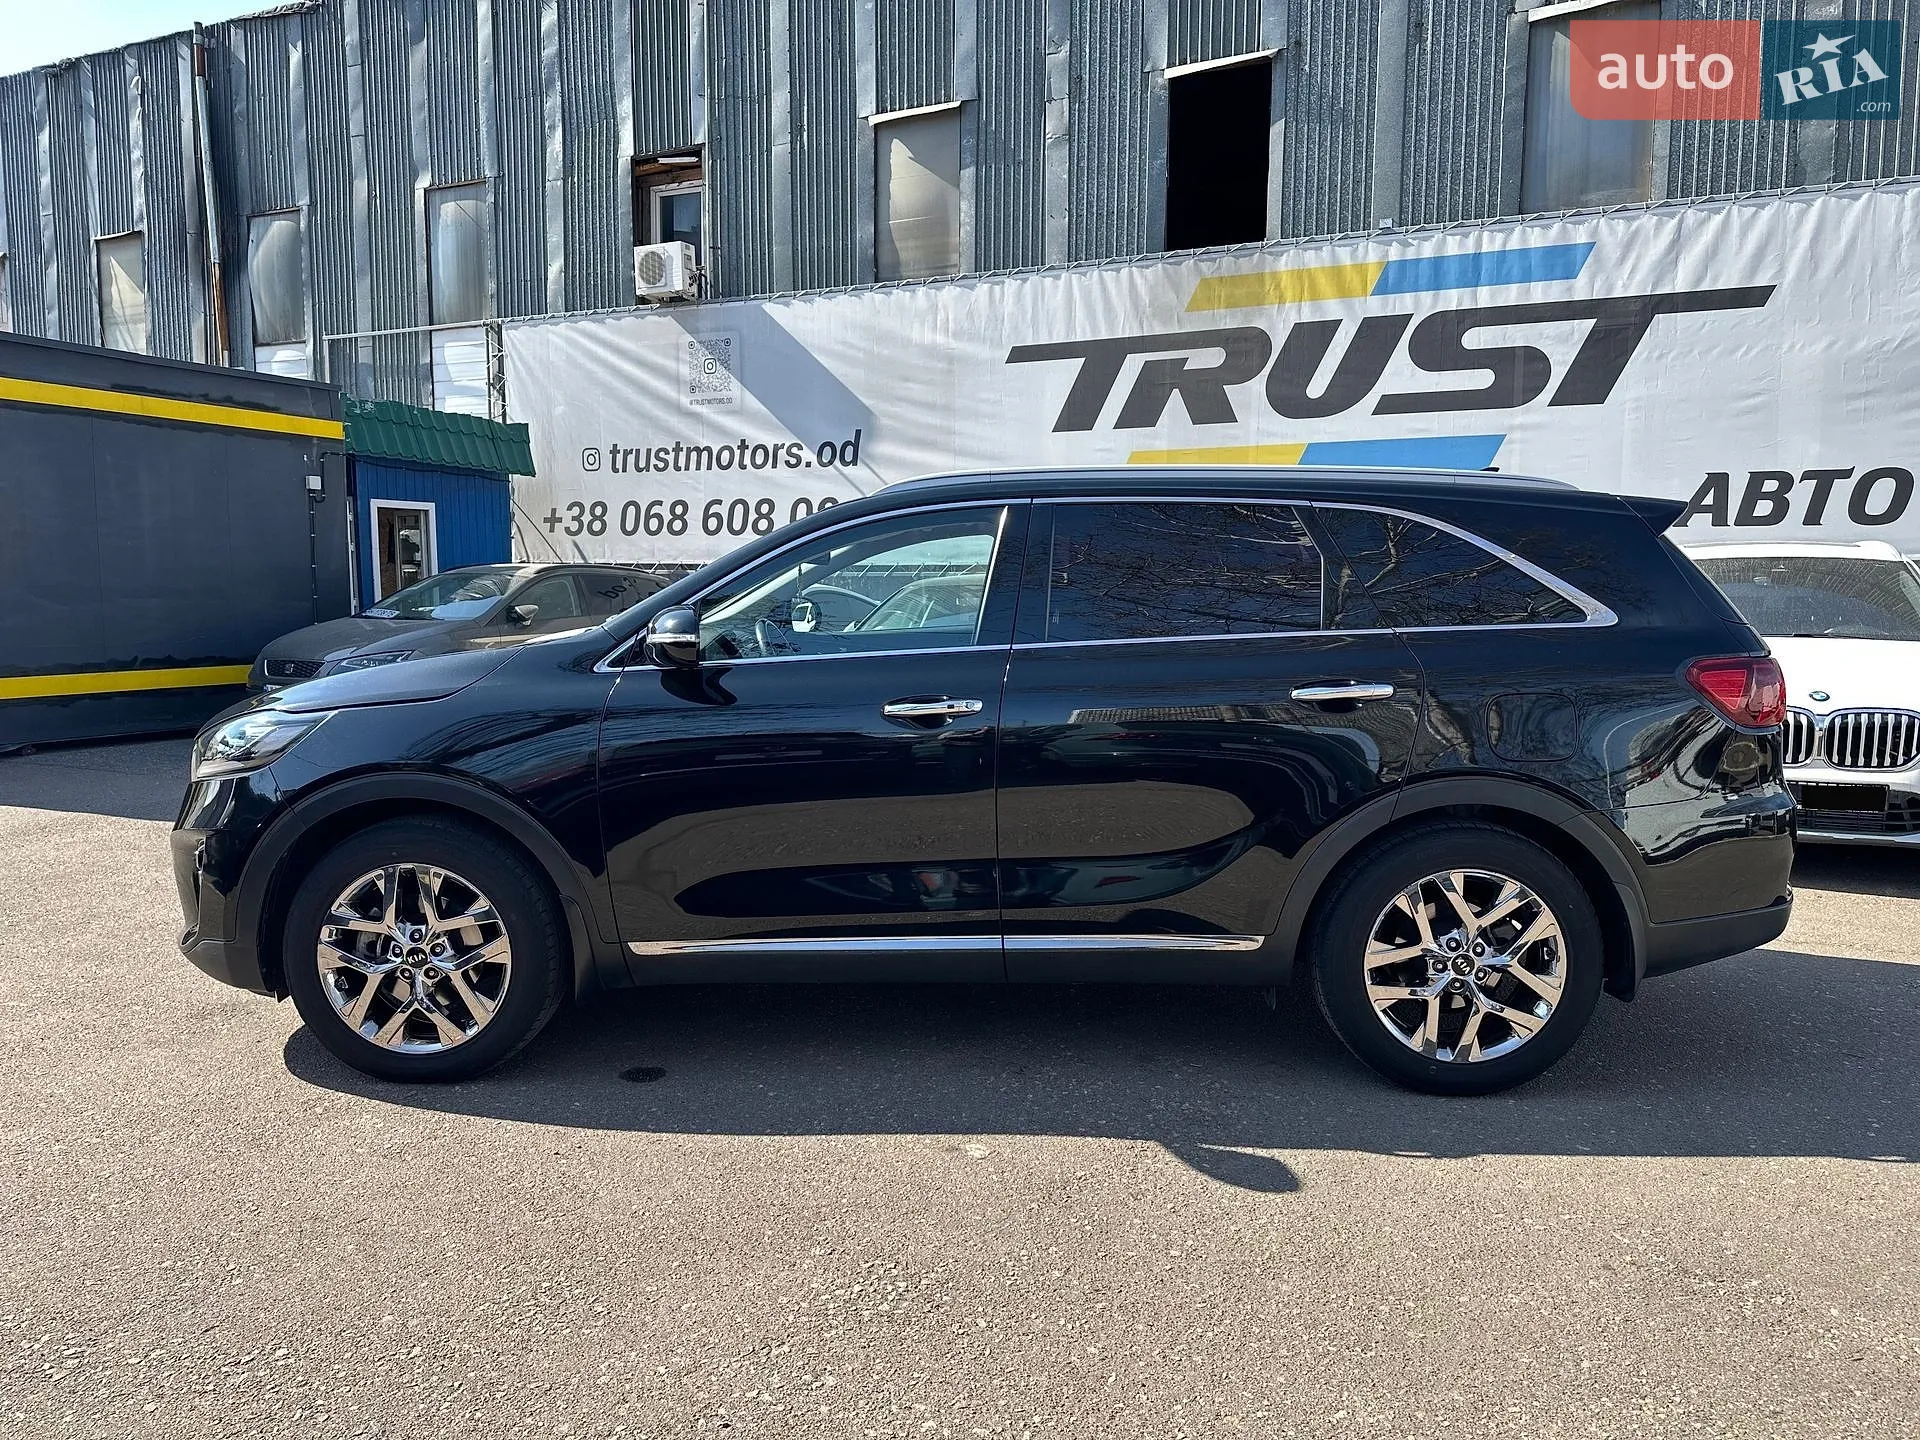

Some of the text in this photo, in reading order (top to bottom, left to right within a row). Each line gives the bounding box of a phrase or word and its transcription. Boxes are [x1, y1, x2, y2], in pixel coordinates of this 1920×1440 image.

[1005, 285, 1778, 432] TRUST
[609, 428, 862, 473] trustmotors.od
[543, 500, 608, 536] +38
[619, 499, 689, 536] 068
[701, 497, 775, 536] 608
[1672, 465, 1915, 527] АВТО
[407, 953, 426, 964] KIA
